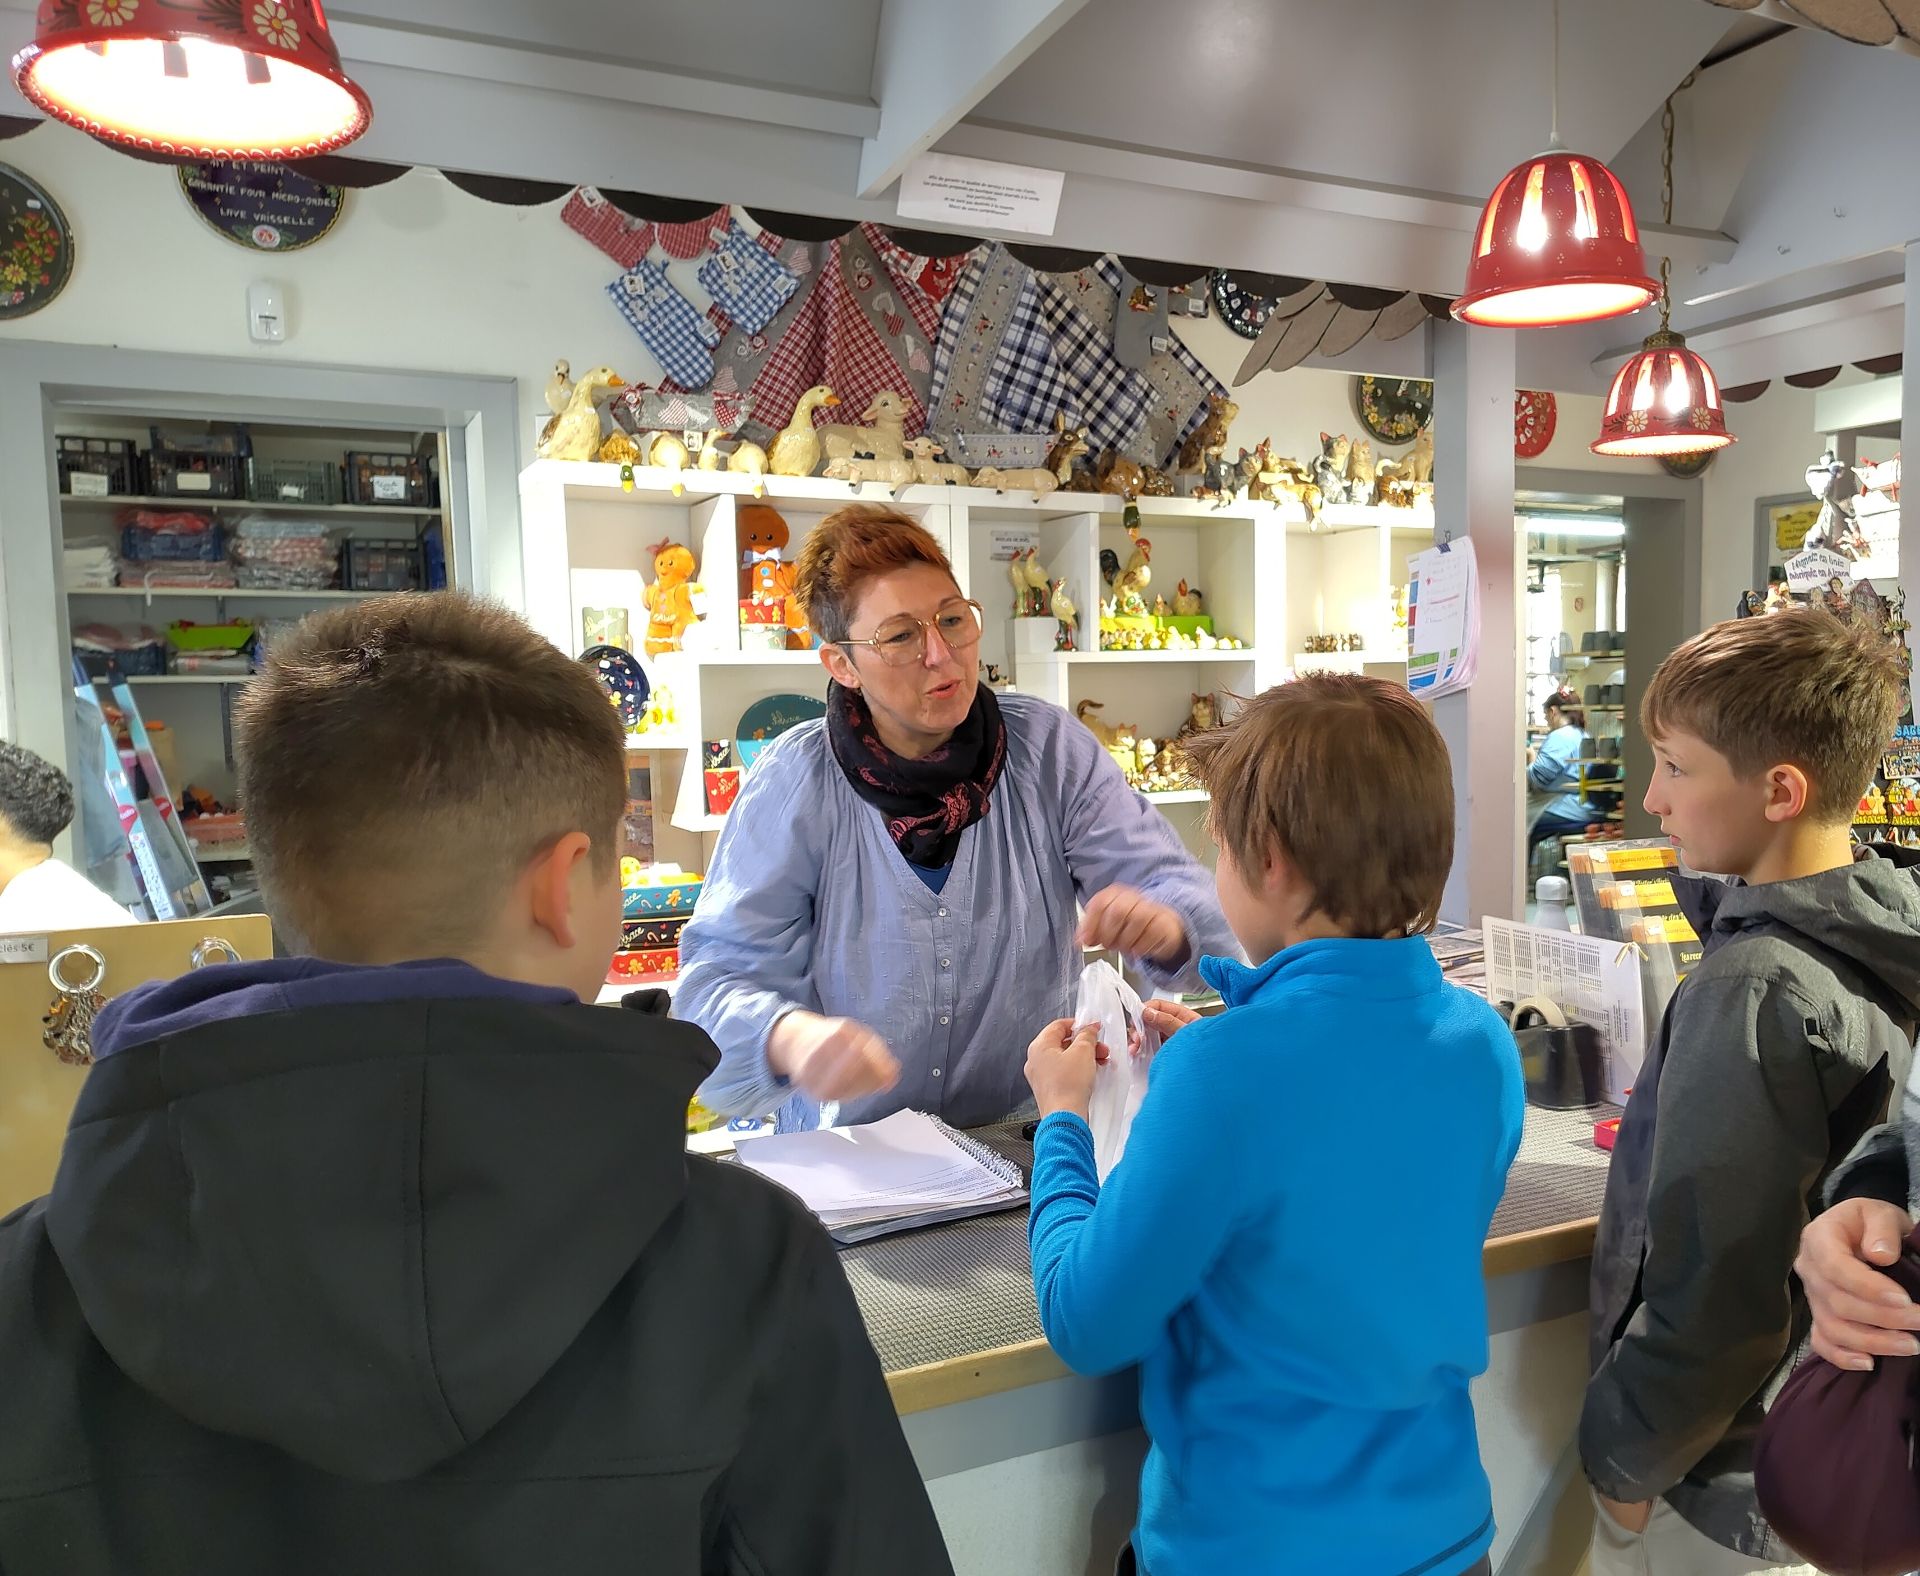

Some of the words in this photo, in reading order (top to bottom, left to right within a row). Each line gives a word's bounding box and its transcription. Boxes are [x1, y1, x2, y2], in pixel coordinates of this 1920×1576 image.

[187, 177, 236, 195] GARANTIE
[240, 187, 266, 198] FOUR
[271, 191, 338, 208] MICRO-ONDES
[219, 206, 248, 220] LAVE
[252, 210, 316, 227] VAISSELLE
[21, 942, 35, 952] 5€
